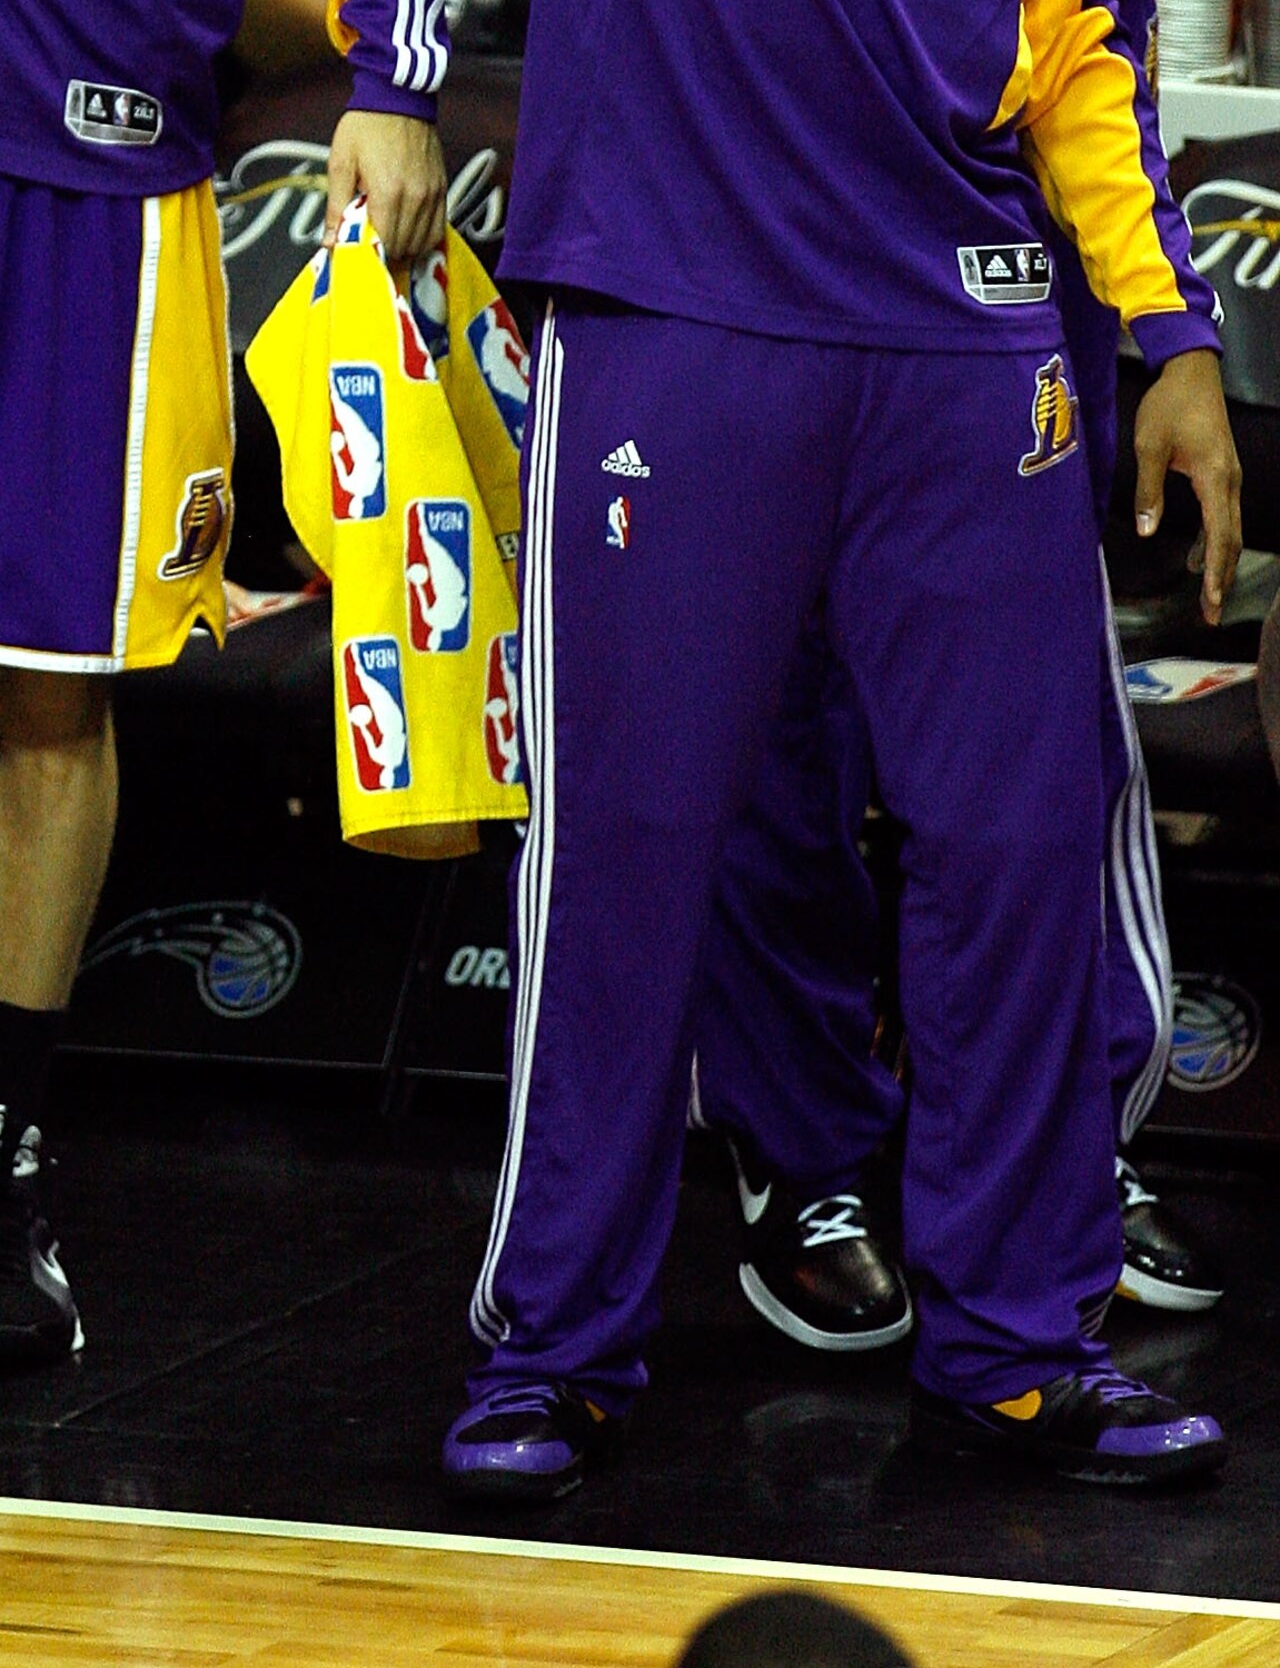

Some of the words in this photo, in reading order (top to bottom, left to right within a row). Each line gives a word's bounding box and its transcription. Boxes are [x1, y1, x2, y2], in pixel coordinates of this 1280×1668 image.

[336, 374, 376, 397] NBA
[601, 458, 650, 478] adidas
[428, 510, 465, 533] NBA
[362, 647, 398, 670] NBA
